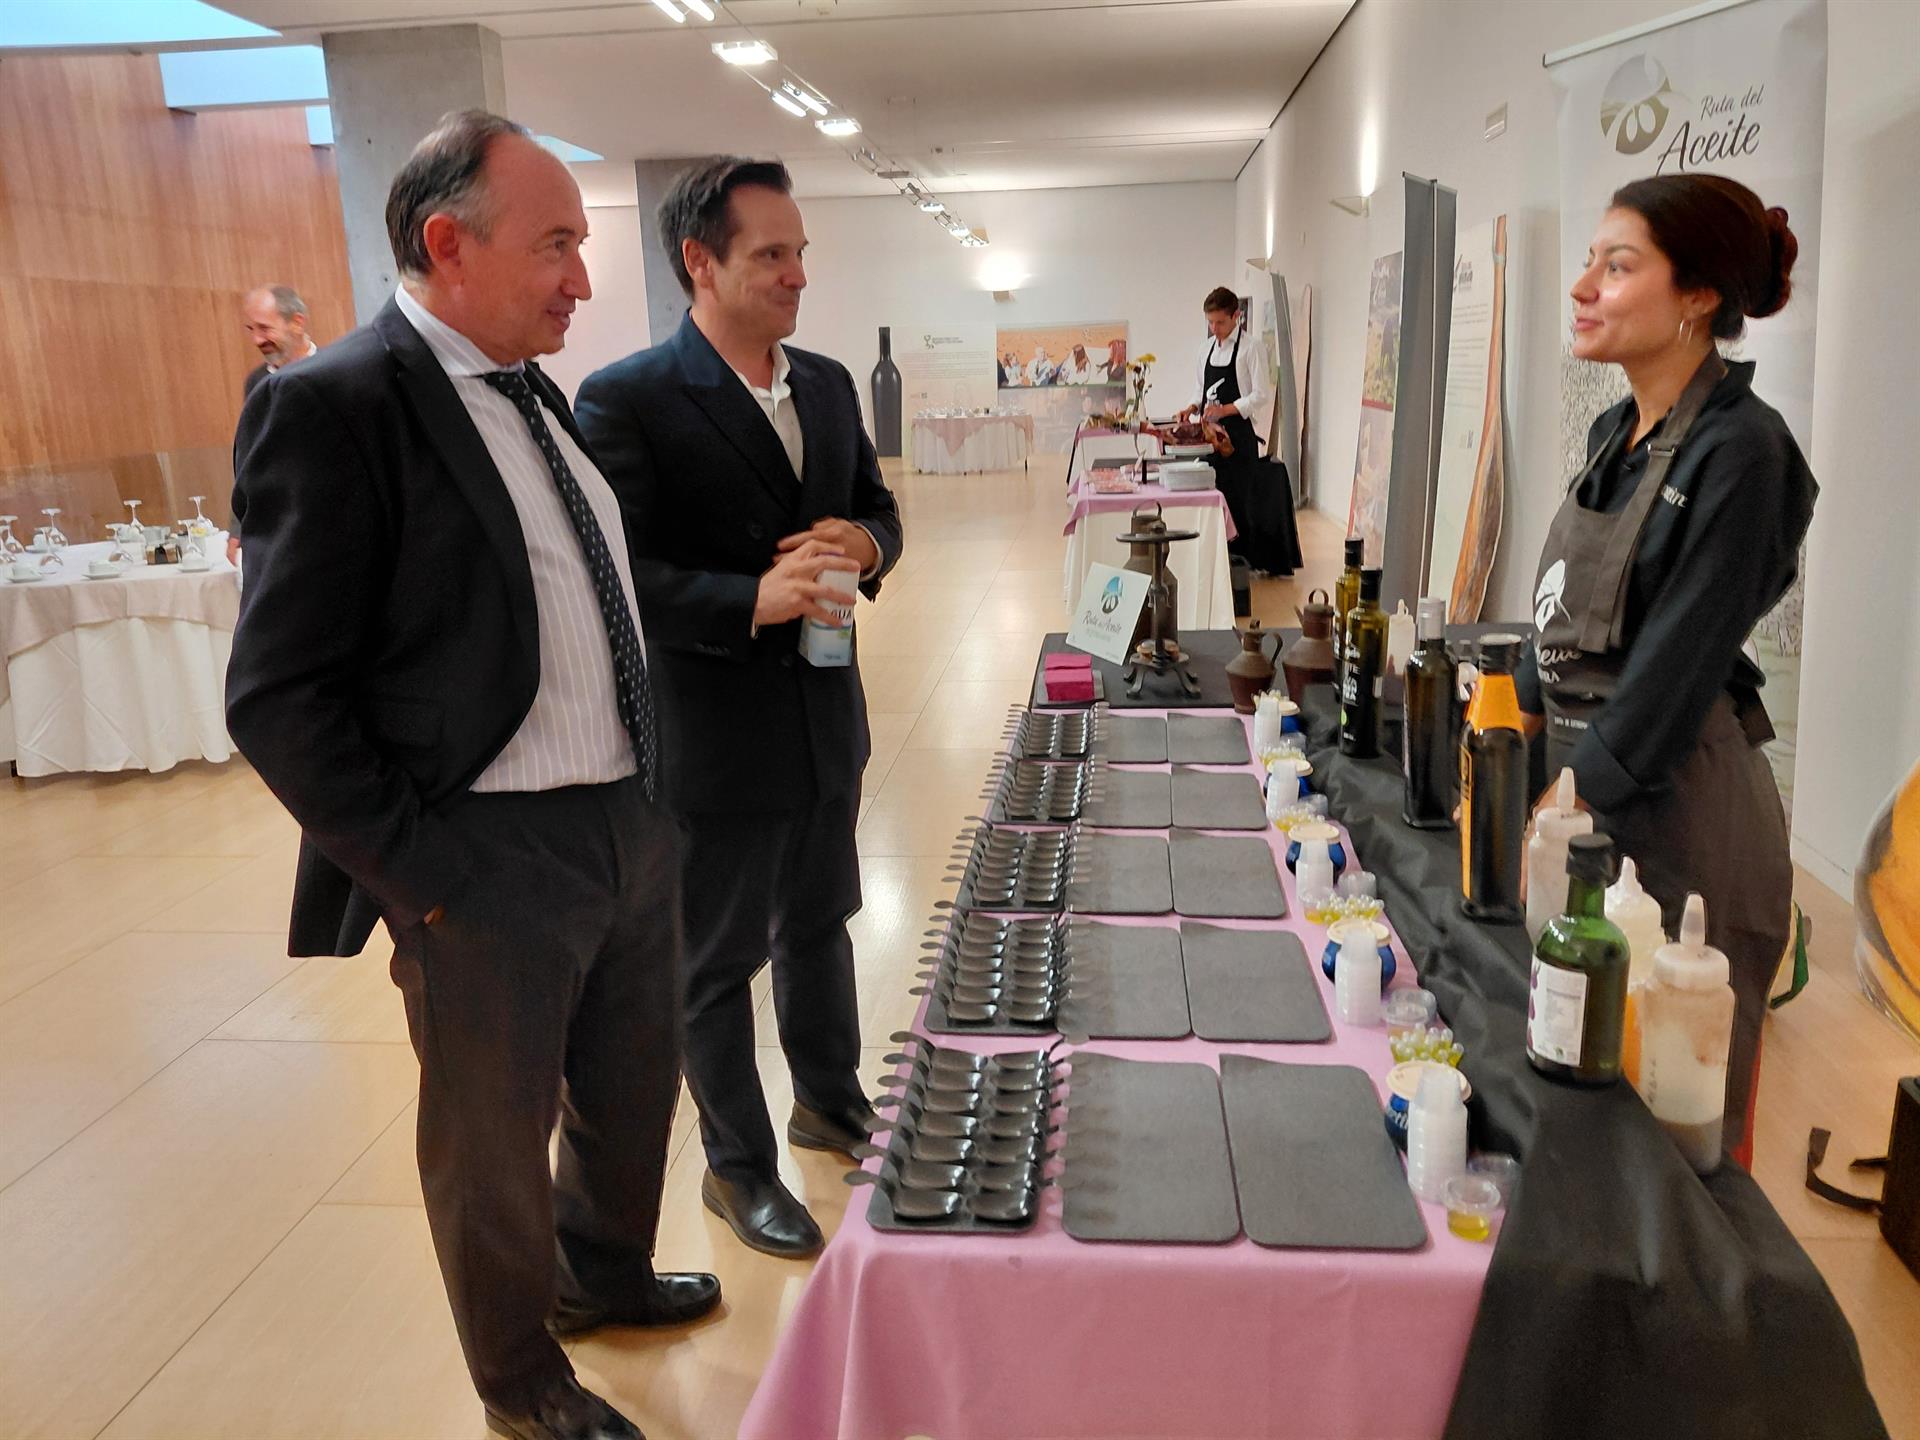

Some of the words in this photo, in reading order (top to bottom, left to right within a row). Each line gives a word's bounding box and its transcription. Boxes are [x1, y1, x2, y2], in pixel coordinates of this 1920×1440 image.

[1700, 95, 1735, 120] Ruta
[1741, 82, 1765, 109] del
[1655, 113, 1761, 176] Aceite
